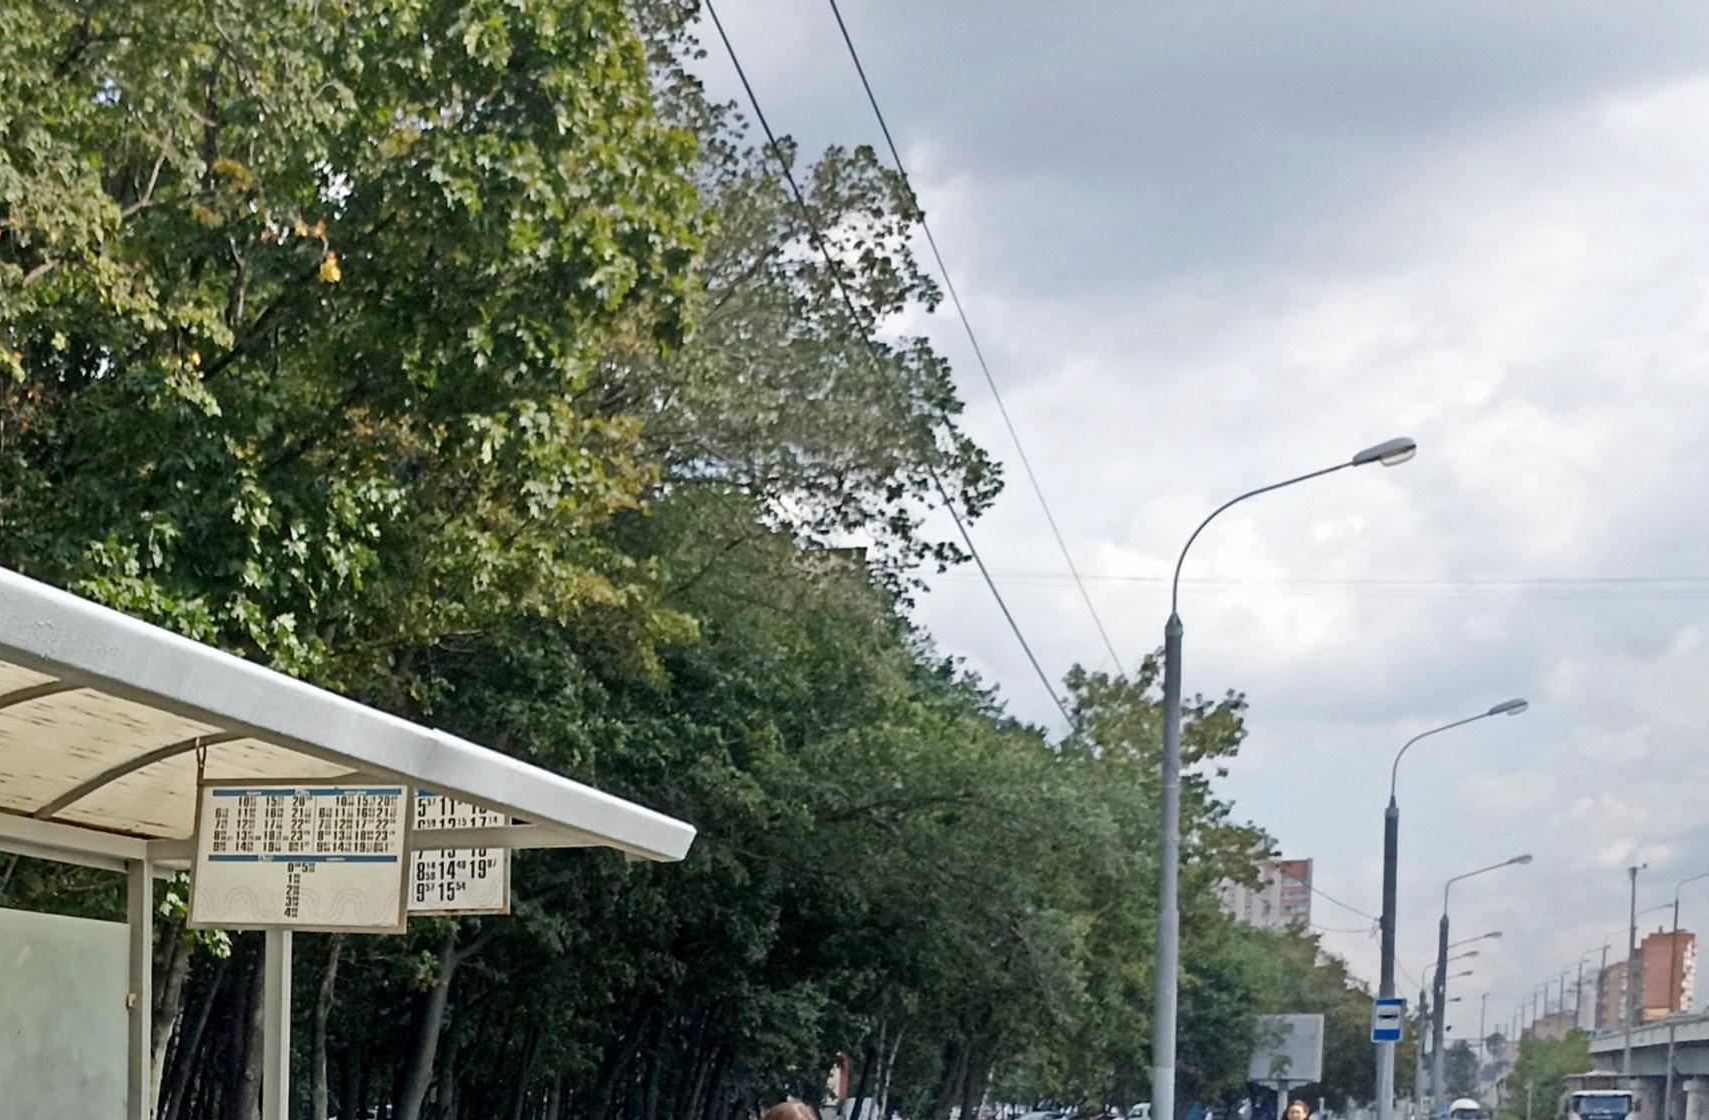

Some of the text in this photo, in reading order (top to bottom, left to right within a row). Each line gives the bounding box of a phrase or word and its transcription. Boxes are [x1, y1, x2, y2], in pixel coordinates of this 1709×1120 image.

[418, 798, 426, 817] 5
[441, 797, 454, 816] 11
[417, 862, 425, 881] 8
[439, 860, 455, 880] 14
[470, 860, 486, 879] 19
[416, 883, 424, 902] 9
[438, 882, 454, 901] 15
